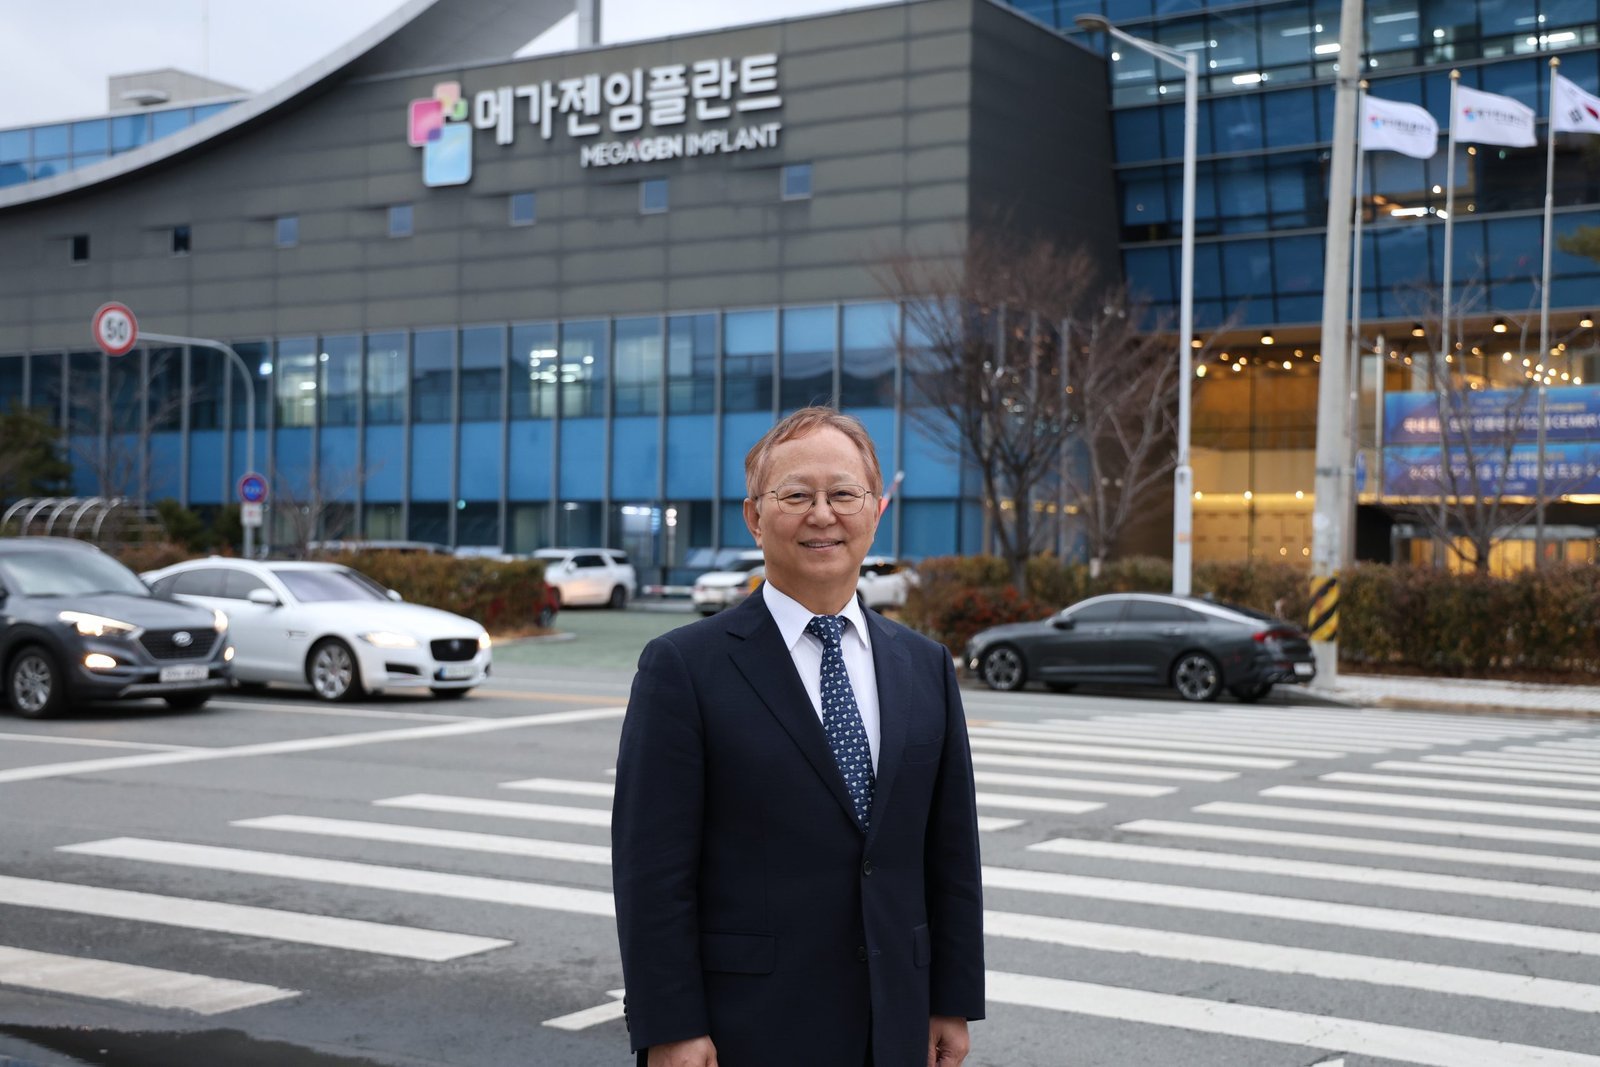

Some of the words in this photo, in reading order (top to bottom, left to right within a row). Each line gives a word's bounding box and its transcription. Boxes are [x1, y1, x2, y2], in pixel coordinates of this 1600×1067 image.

[474, 53, 782, 145] 메가젠임플란트
[685, 122, 782, 157] IMPLANT
[105, 317, 128, 340] 50
